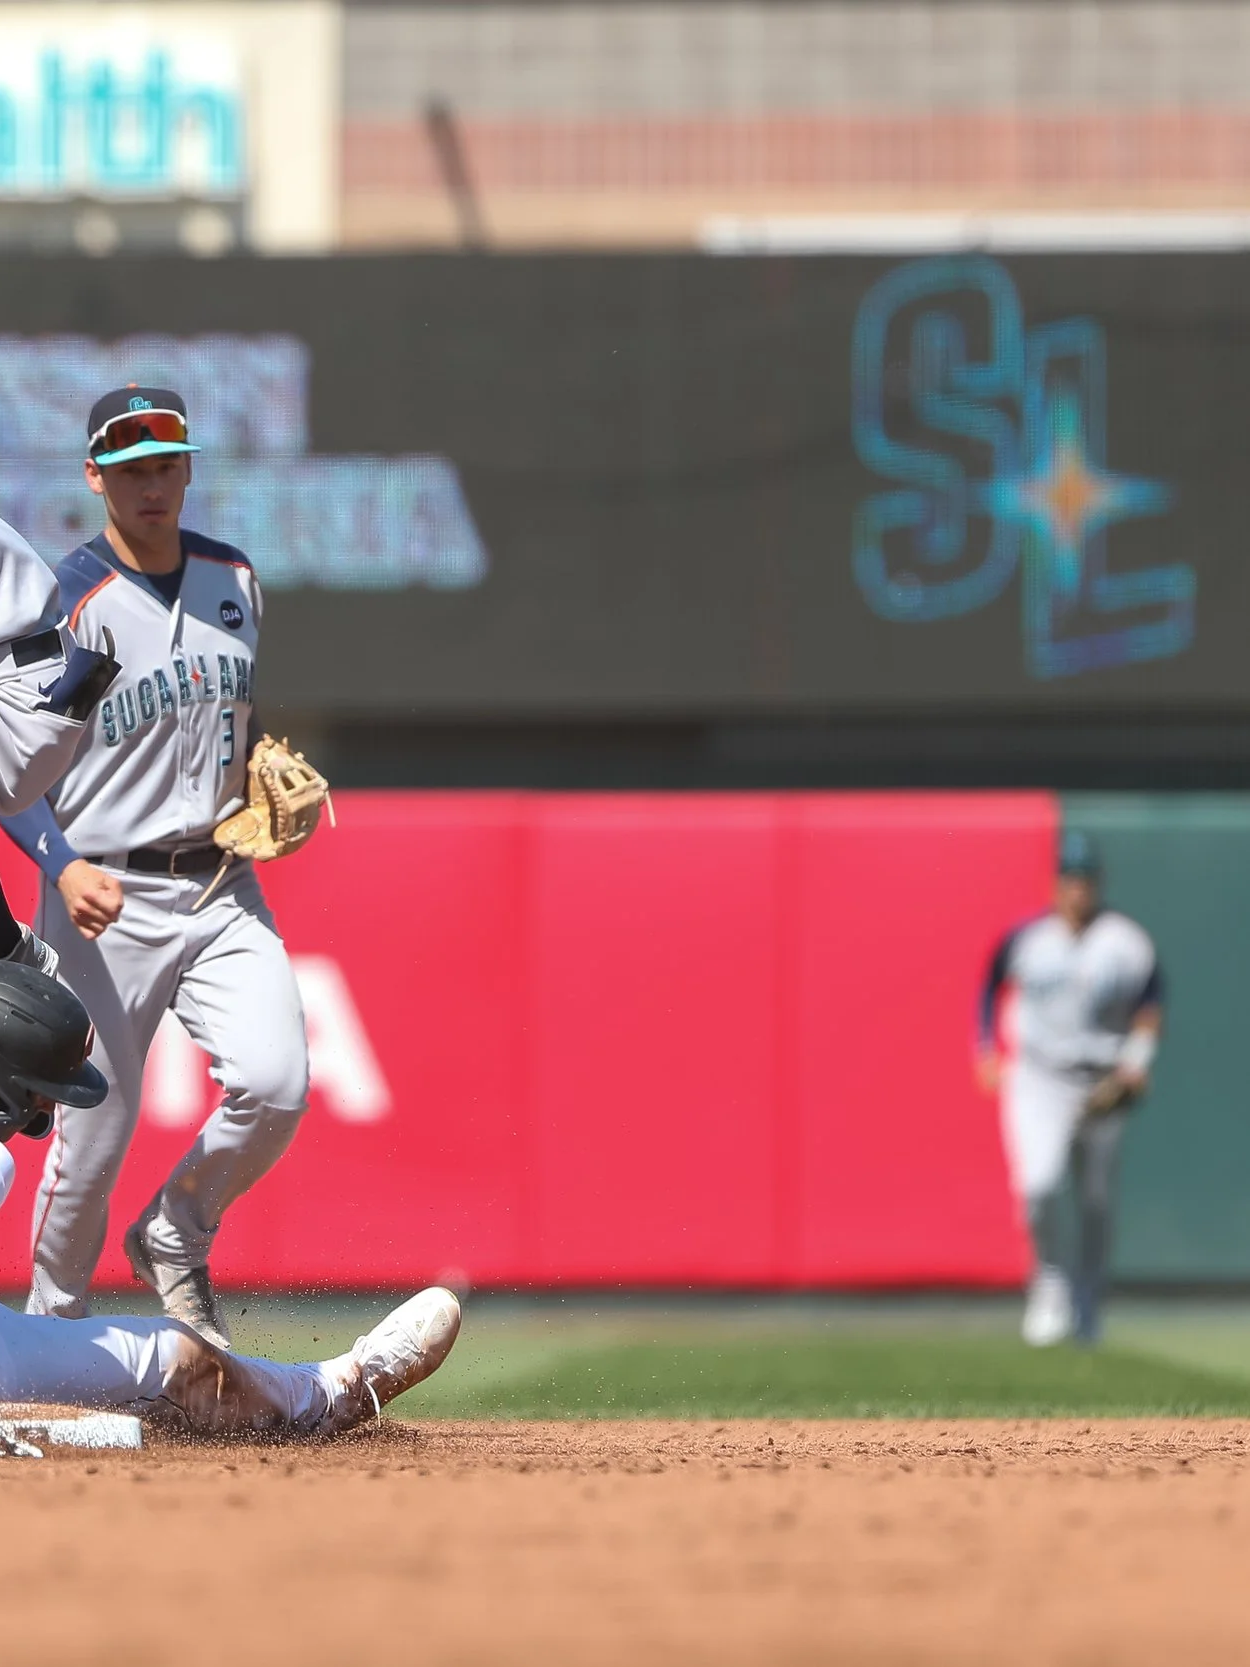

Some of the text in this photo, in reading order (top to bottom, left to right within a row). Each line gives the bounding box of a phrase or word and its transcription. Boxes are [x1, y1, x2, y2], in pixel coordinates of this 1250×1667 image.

[222, 608, 241, 621] DJ4
[100, 652, 254, 747] SUGAR LAN
[220, 708, 235, 767] 3
